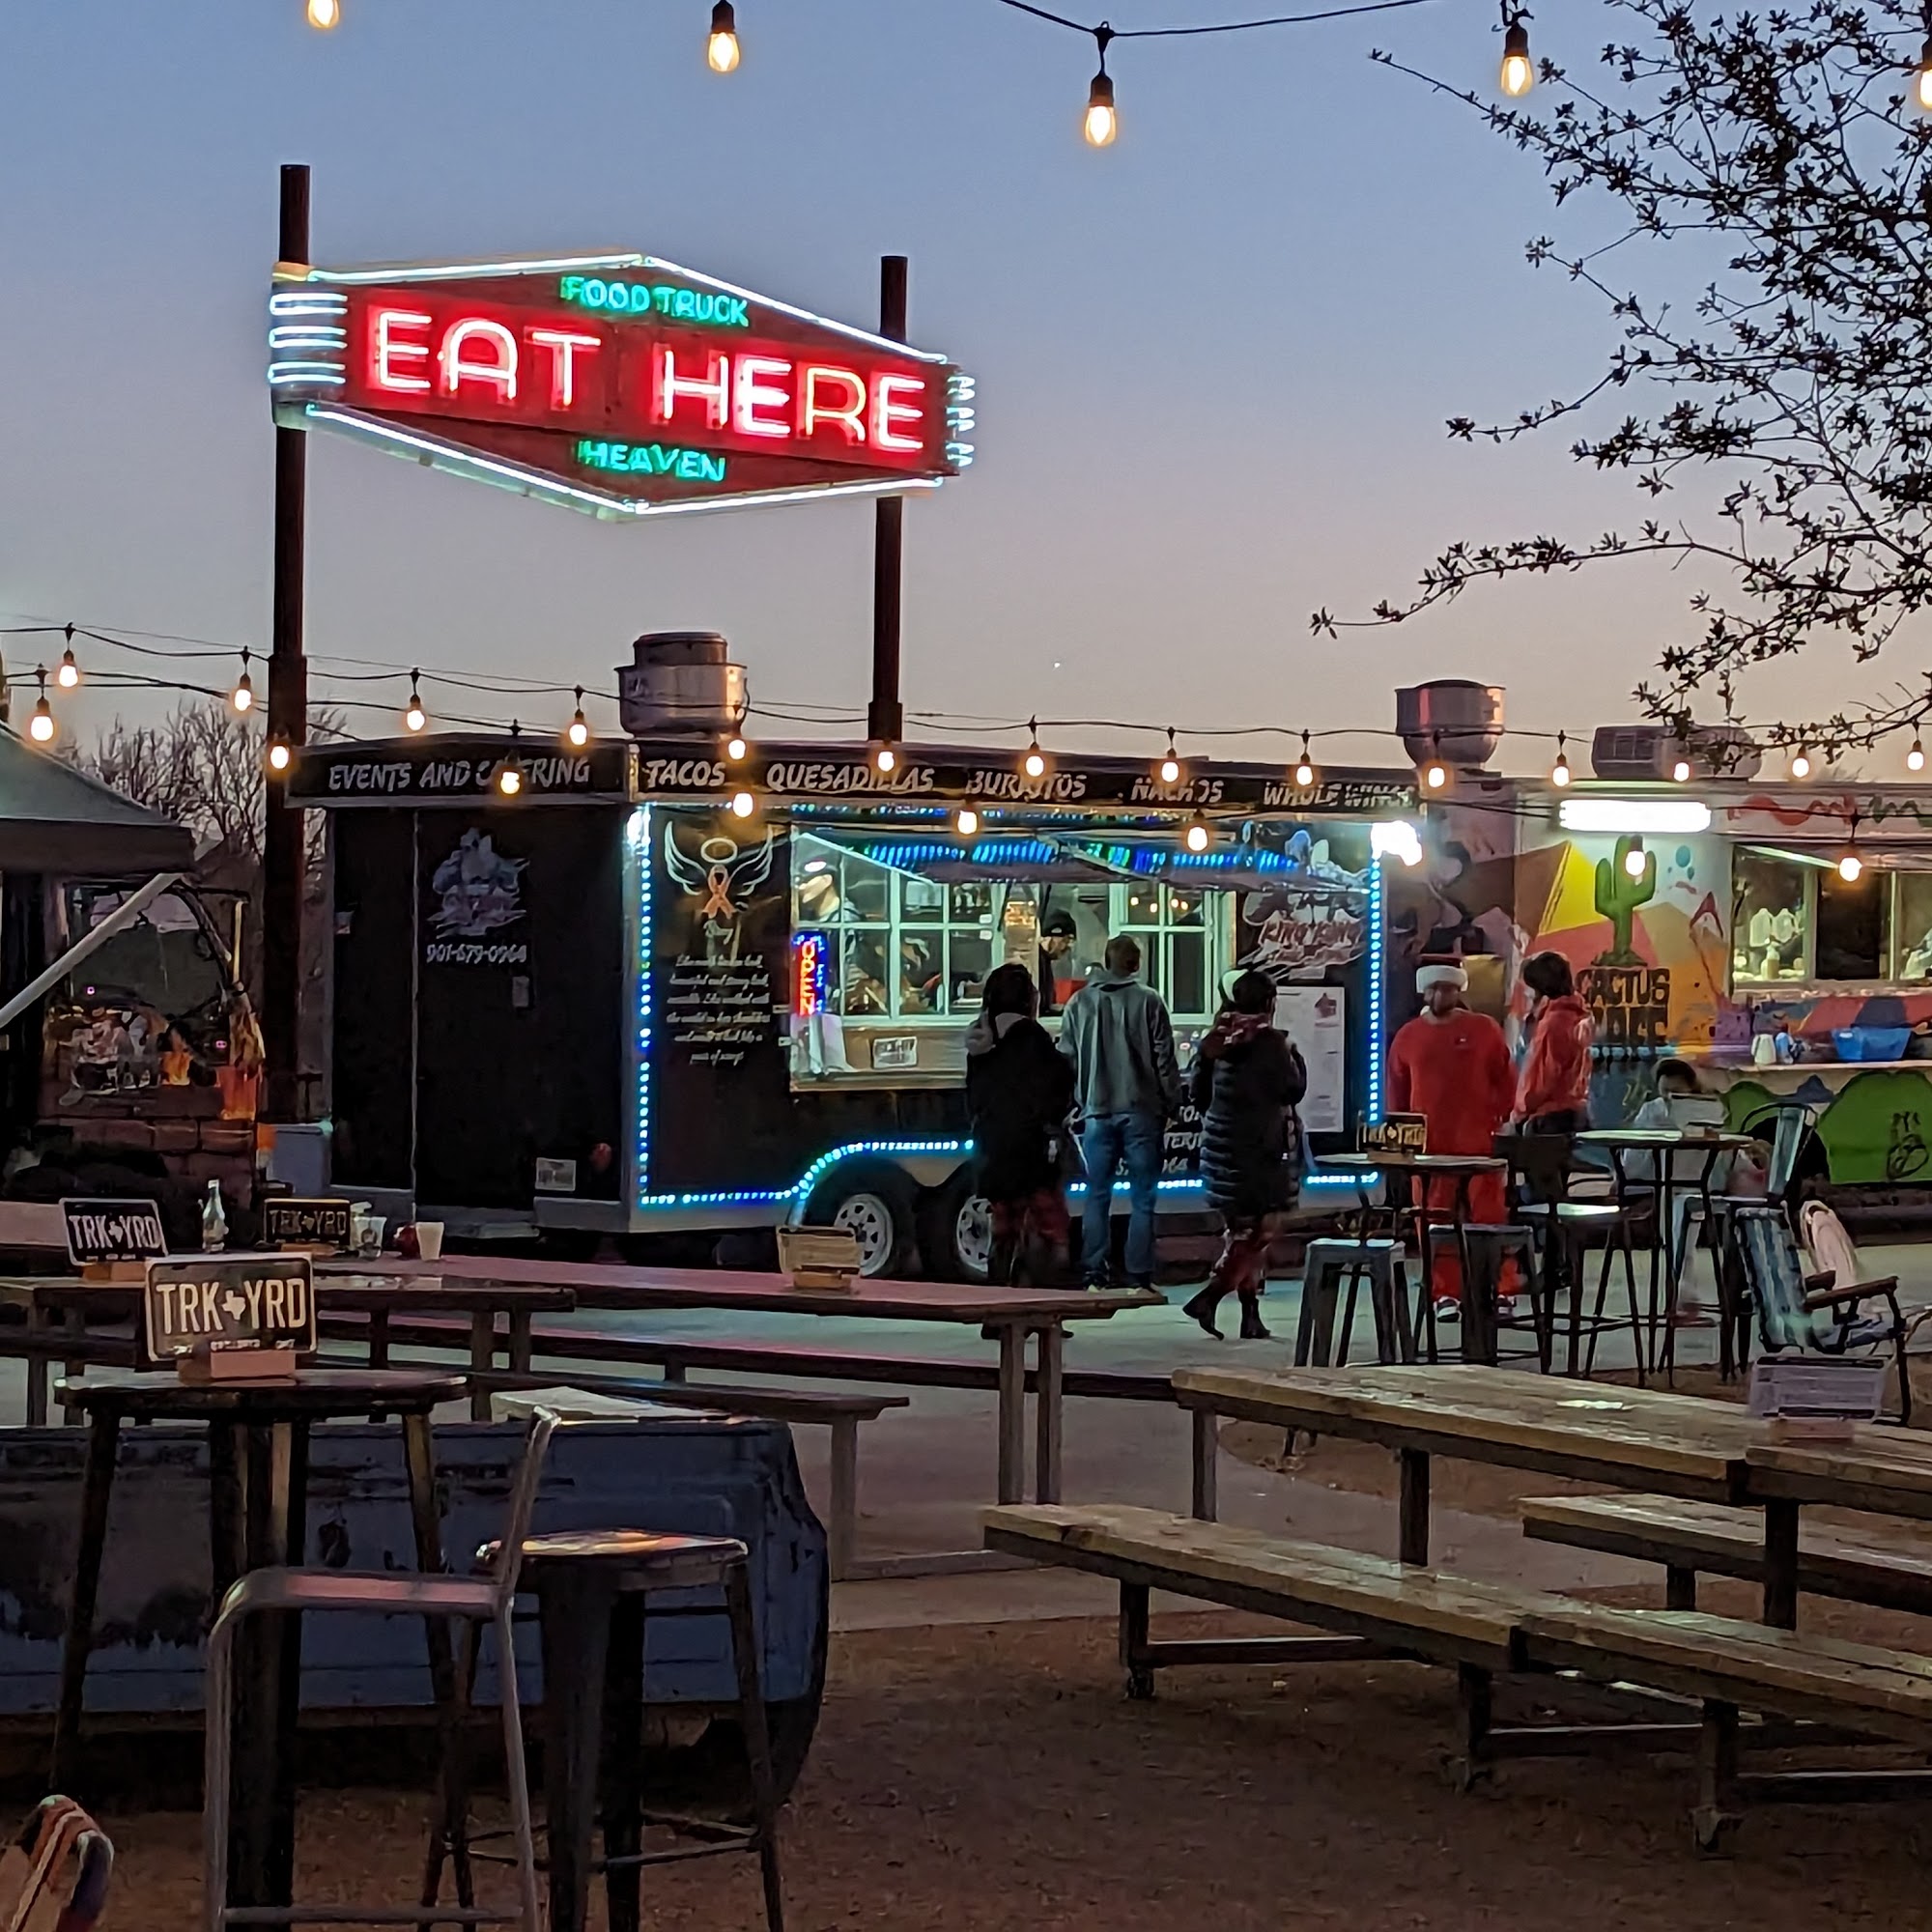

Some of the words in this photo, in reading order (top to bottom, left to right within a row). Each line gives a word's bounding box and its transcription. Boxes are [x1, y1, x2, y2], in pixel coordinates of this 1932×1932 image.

[560, 276, 650, 312] FOOD
[653, 286, 749, 327] TRUCK
[371, 310, 601, 408] EAT
[657, 348, 925, 451] HERE
[578, 440, 725, 481] HEAVEN
[328, 762, 412, 792] EVENTS
[419, 760, 470, 788] AND
[475, 757, 590, 788] CERING
[644, 759, 724, 787] TACOS
[766, 763, 935, 792] QUESADILLAS
[966, 771, 1088, 800] BURTOS
[800, 941, 815, 1016] OPEN
[1575, 967, 1670, 1007] CACTUS
[69, 1214, 112, 1249] TRK
[120, 1215, 162, 1249] YRD
[156, 1281, 223, 1335] TRK
[244, 1278, 307, 1328] YRD
